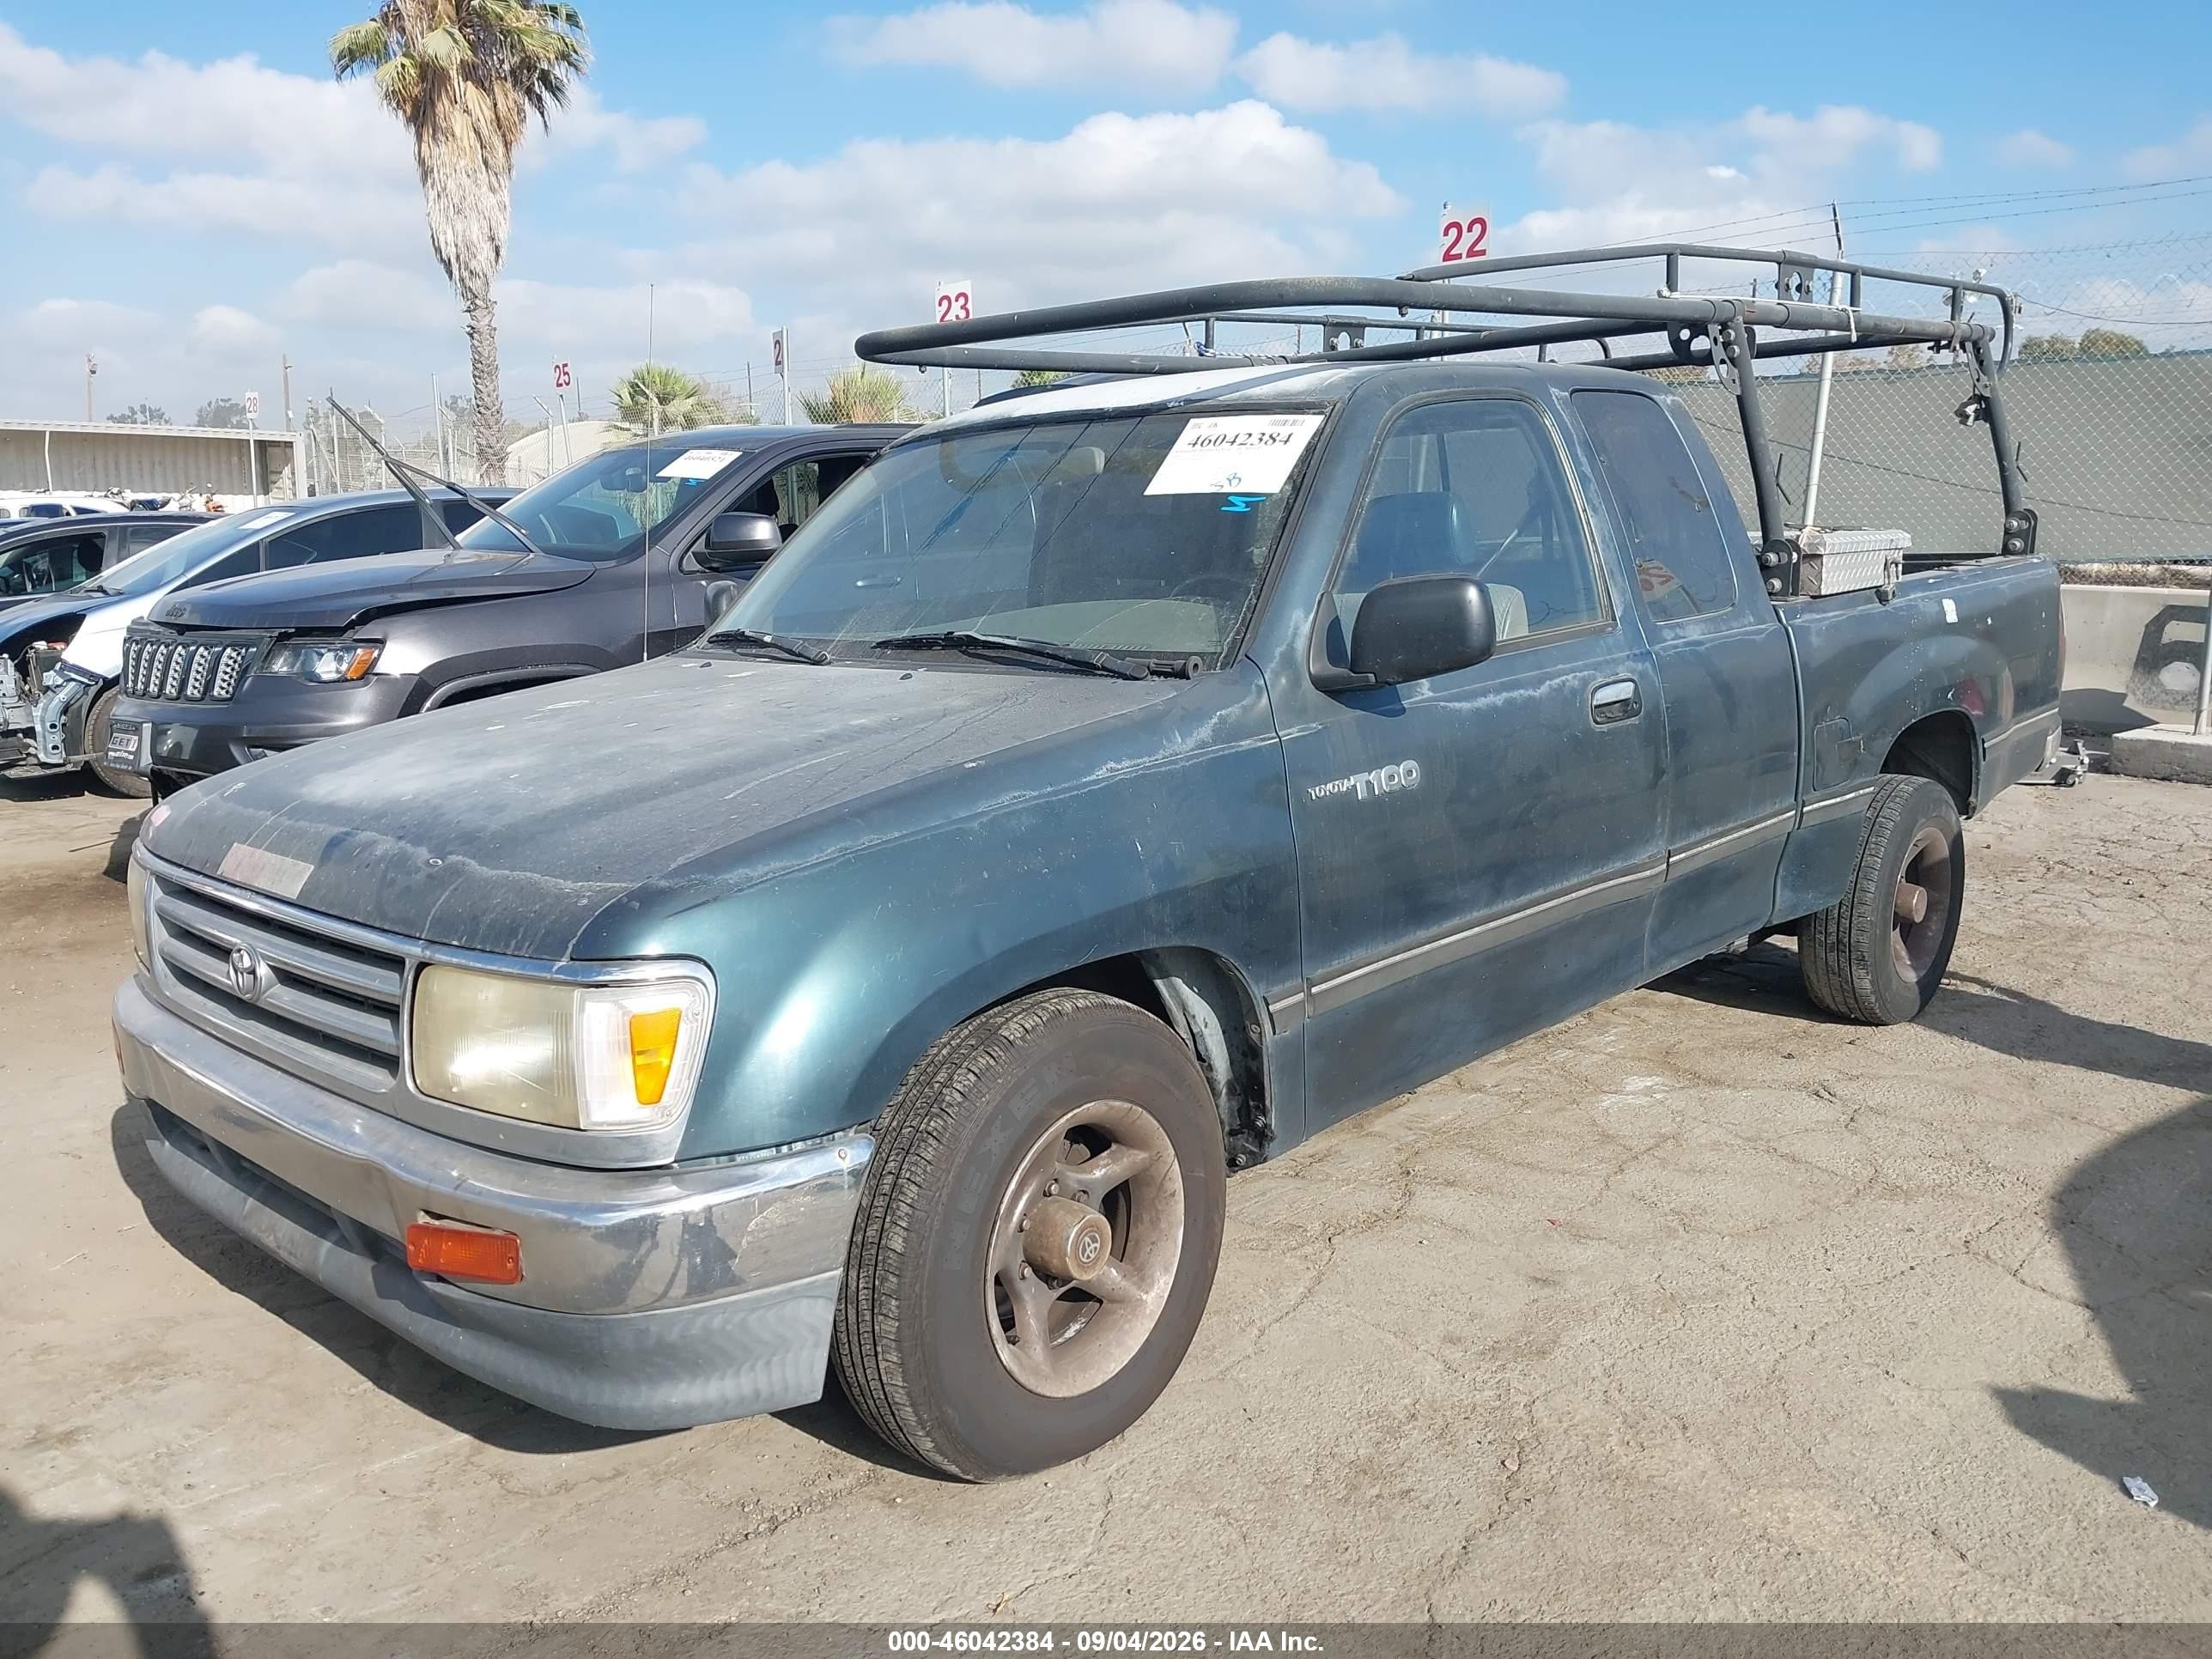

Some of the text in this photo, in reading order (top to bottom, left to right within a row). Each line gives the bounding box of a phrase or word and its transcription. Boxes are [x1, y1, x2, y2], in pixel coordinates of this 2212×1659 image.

[1443, 216, 1487, 262] 22
[938, 292, 970, 323] 23
[775, 339, 782, 366] 2
[554, 362, 570, 387] 25
[247, 397, 258, 413] 28
[1188, 432, 1293, 447] 46042384
[1307, 759, 1420, 801] TOYOTA T100
